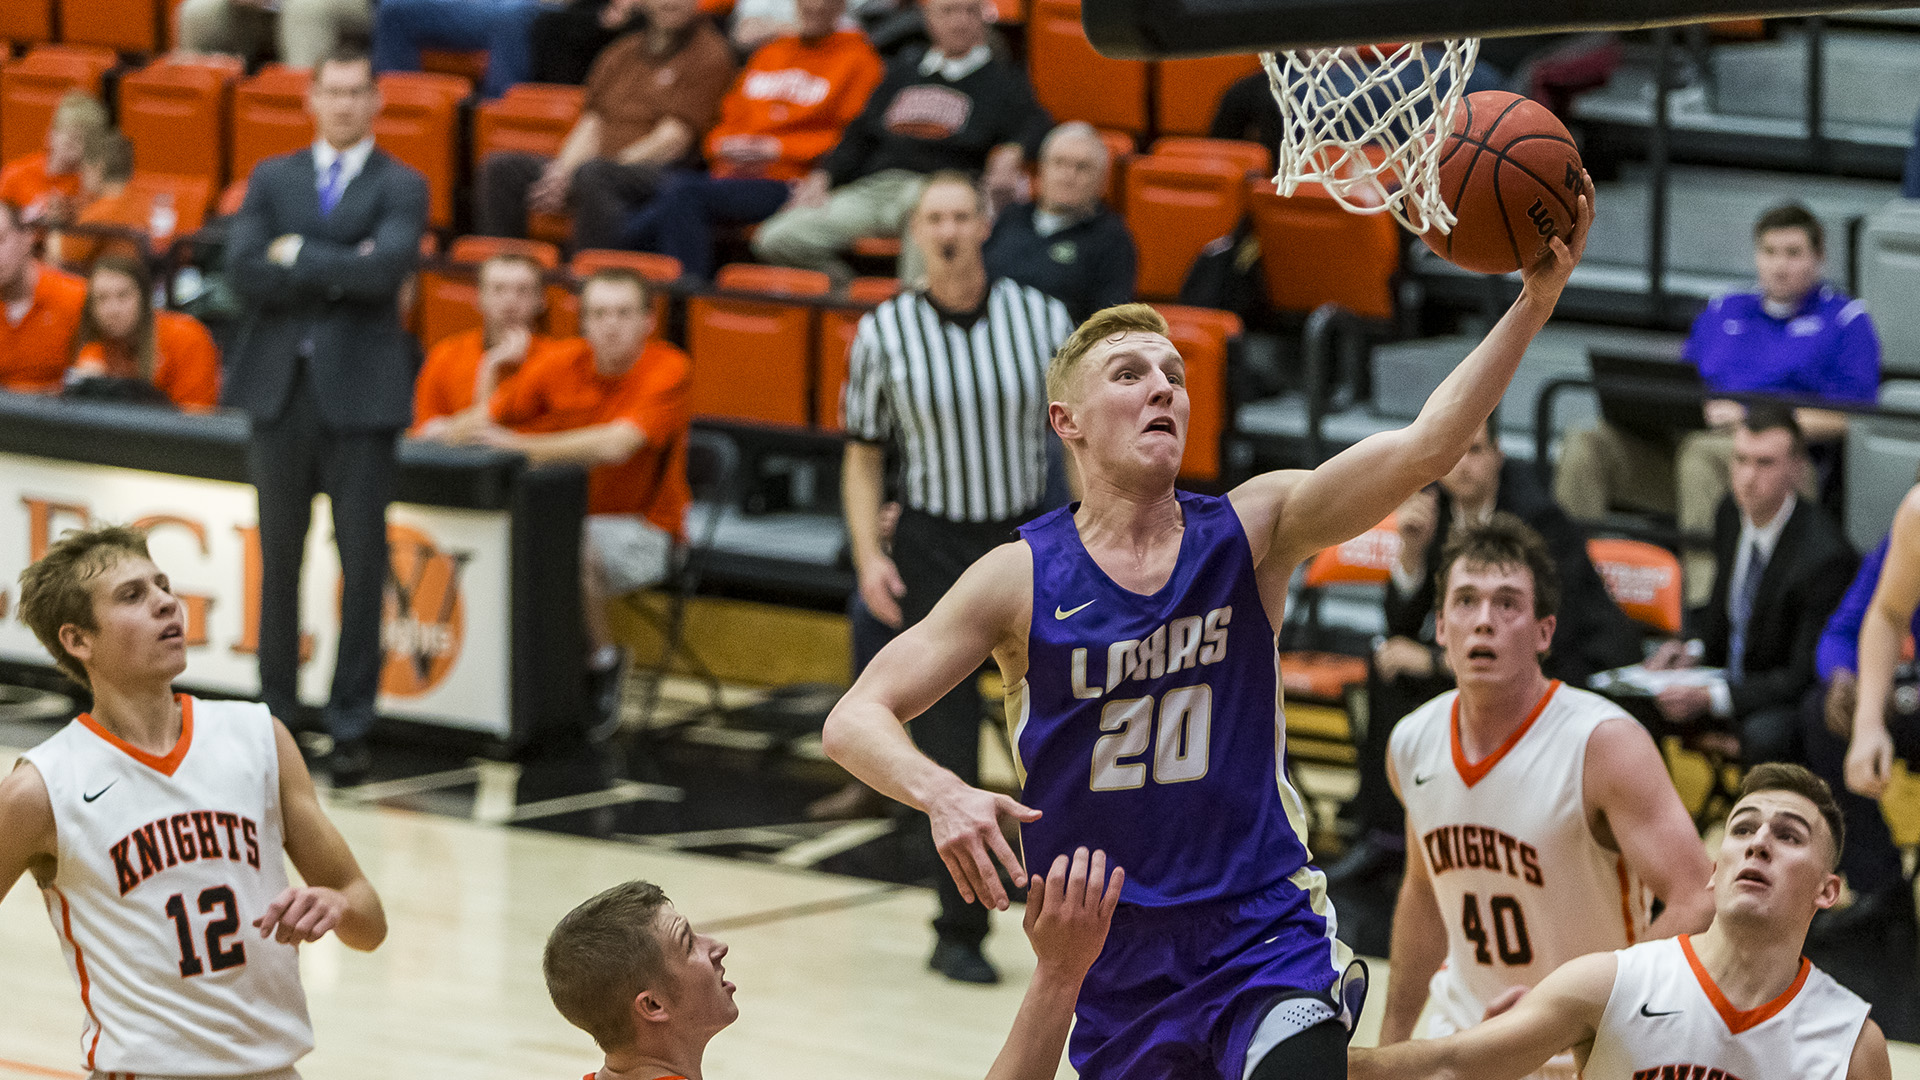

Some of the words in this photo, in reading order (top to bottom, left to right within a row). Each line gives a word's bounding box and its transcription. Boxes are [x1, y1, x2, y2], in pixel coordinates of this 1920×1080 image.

[1071, 605, 1232, 699] LORAS
[1089, 683, 1212, 791] 20
[109, 810, 260, 897] KNIGHTS
[165, 884, 246, 979] 12
[1462, 893, 1534, 966] 40
